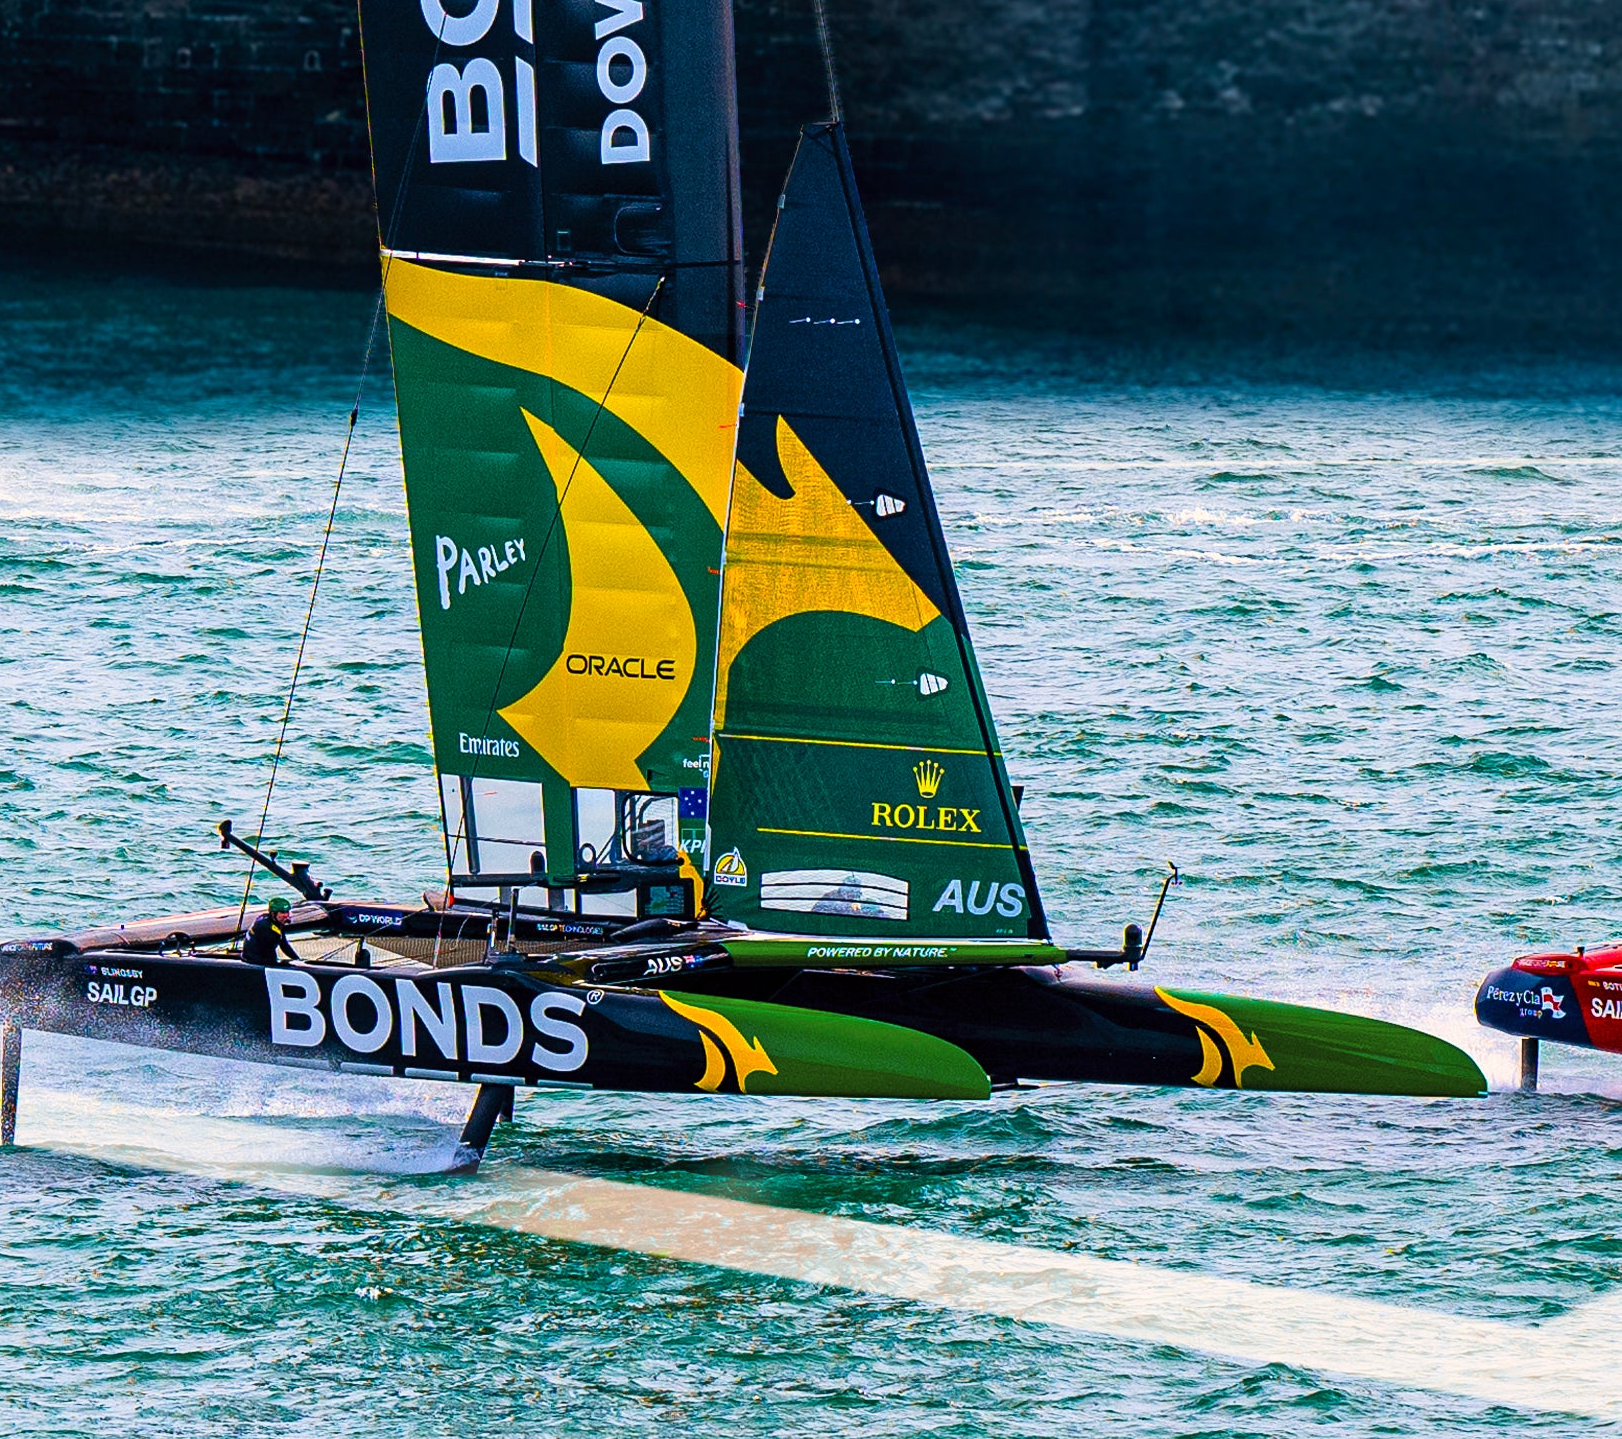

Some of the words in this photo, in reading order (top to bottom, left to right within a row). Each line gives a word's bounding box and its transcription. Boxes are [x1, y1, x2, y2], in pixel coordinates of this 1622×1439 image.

[435, 535, 526, 610] PARLEY
[566, 654, 675, 680] ORACLE
[459, 732, 519, 758] Emirates
[683, 759, 702, 768] feel
[871, 801, 981, 833] ROLEX
[715, 876, 746, 884] DOYLE
[933, 879, 1025, 918] AUS
[807, 946, 872, 957] POWERED
[873, 946, 892, 957] BY
[644, 956, 682, 975] AUS
[87, 980, 157, 1007] SAILGP
